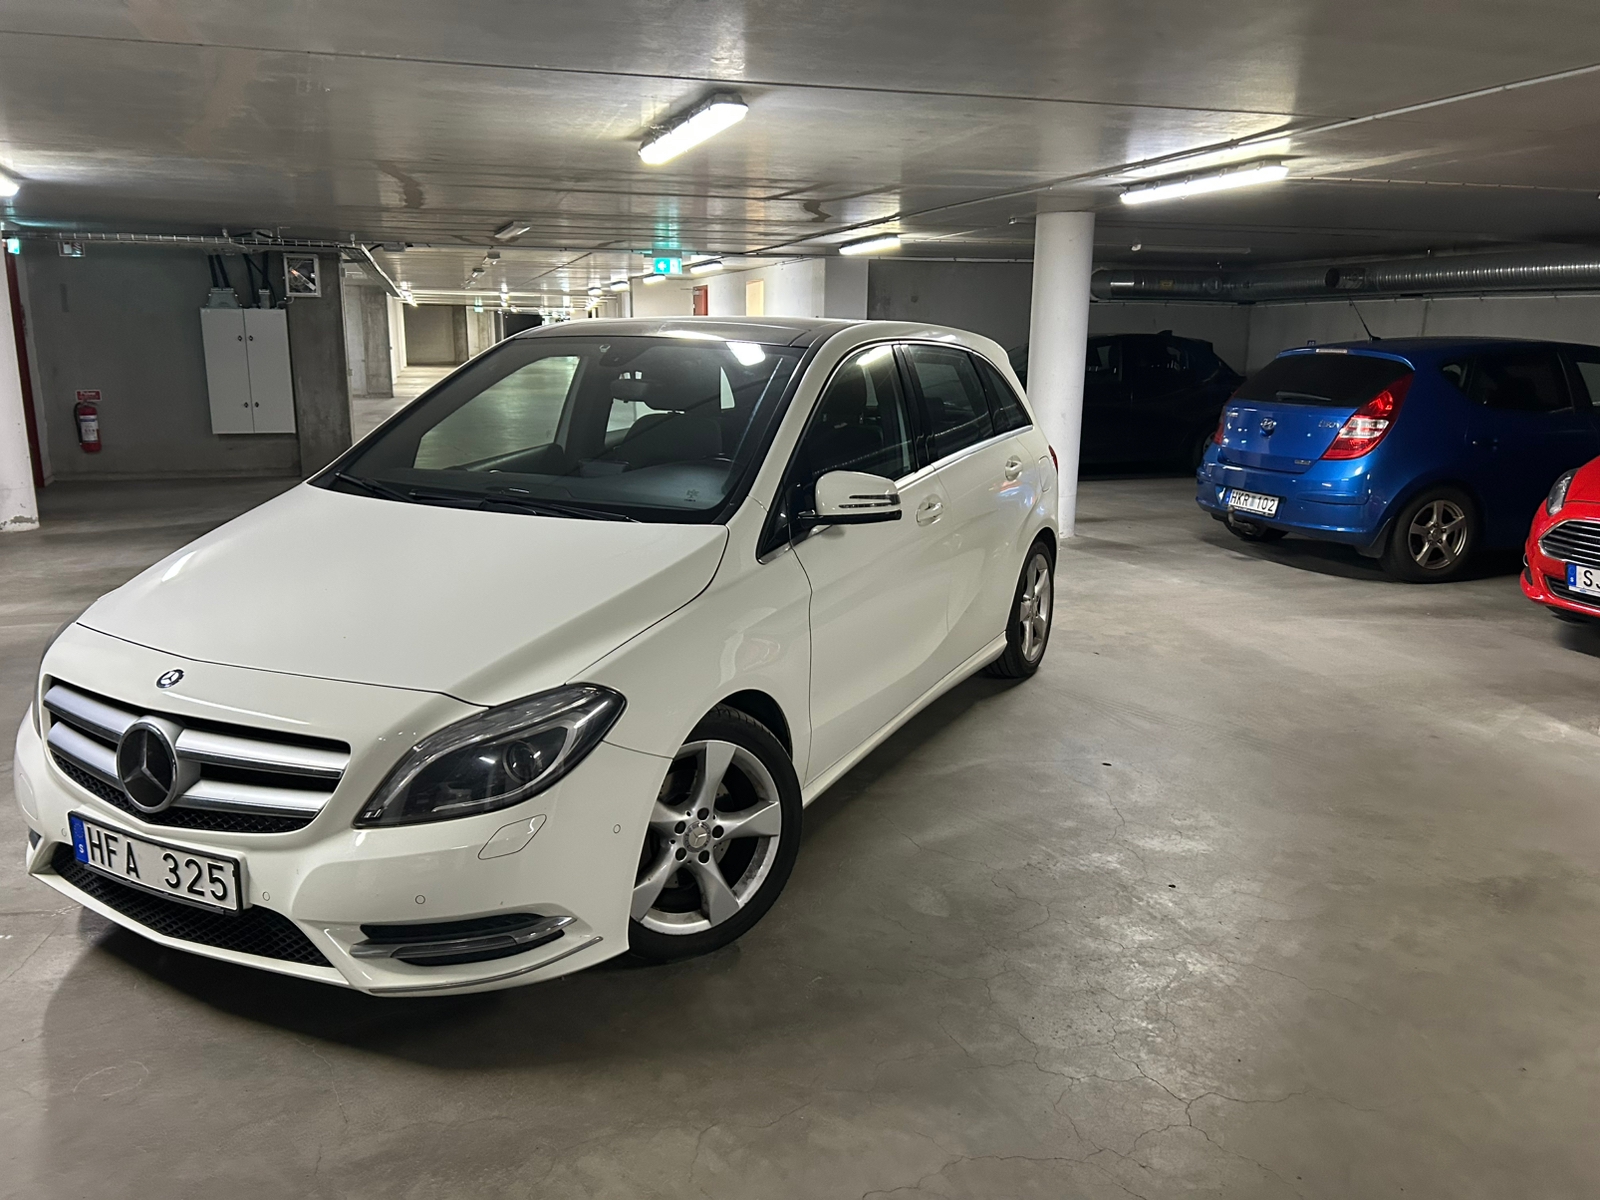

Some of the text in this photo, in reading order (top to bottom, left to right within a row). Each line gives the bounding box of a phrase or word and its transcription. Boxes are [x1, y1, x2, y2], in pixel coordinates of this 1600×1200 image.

[1231, 490, 1275, 512] HKR 102
[87, 825, 227, 901] HFA 325
